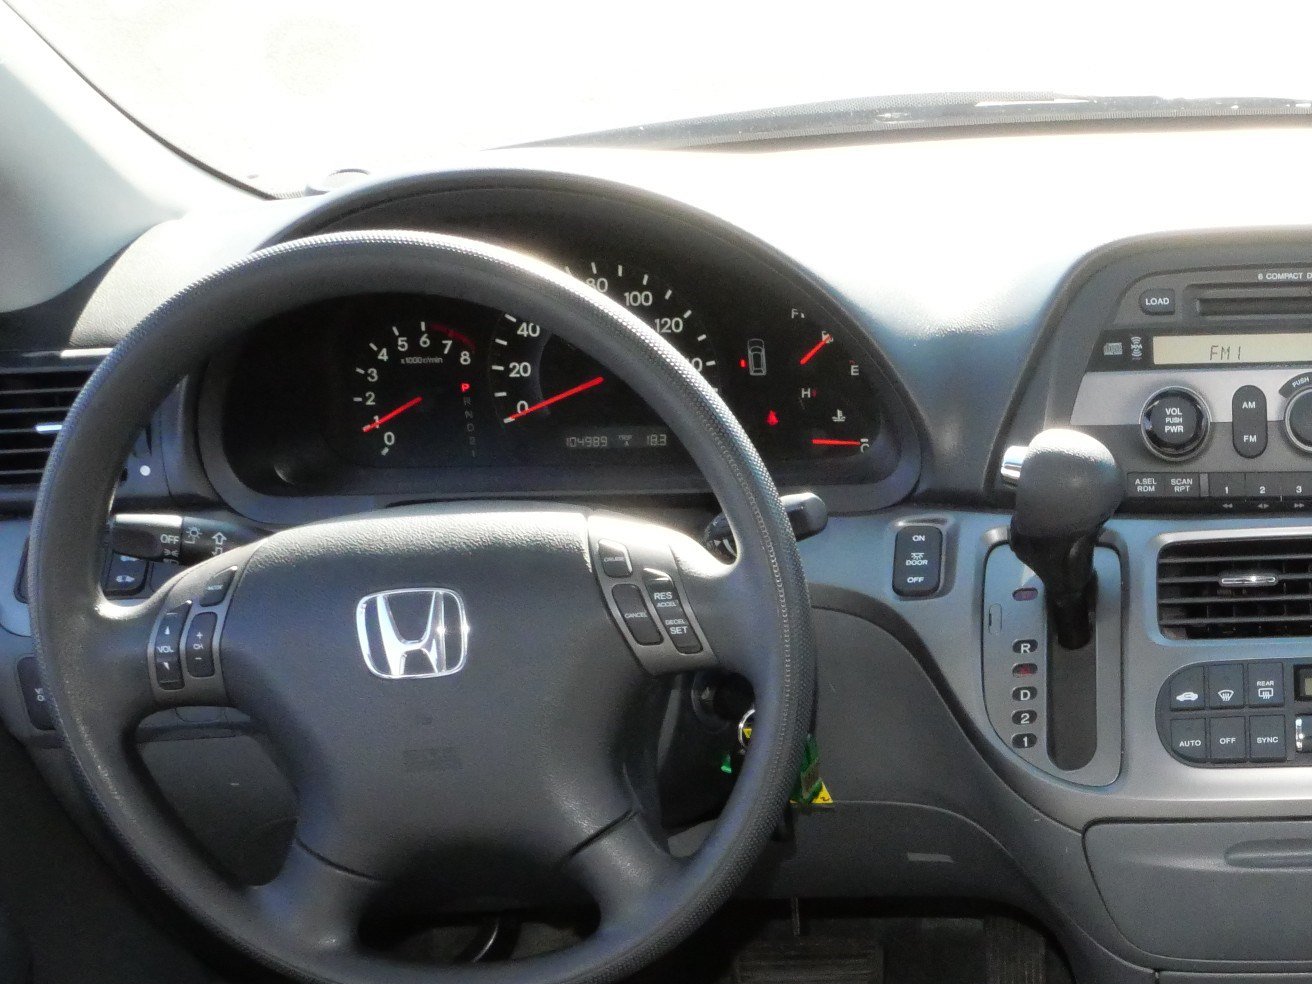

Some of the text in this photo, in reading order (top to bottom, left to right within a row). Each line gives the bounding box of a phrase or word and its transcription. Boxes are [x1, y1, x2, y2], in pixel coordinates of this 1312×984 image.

[1257, 272, 1264, 280] 6
[1266, 272, 1303, 280] COMPACT
[624, 291, 653, 307] 100
[1145, 298, 1170, 306] LOAD
[791, 308, 799, 319] F
[516, 322, 540, 338] 40
[654, 318, 684, 333] 120
[397, 336, 408, 352] 5
[420, 333, 430, 348] 6
[442, 340, 452, 354] 7
[1210, 344, 1242, 360] FM1
[377, 348, 388, 362] 4
[460, 350, 471, 365] 8
[366, 368, 378, 382] 3
[508, 362, 532, 378] 20
[850, 364, 860, 376] E
[461, 382, 470, 392] P
[1292, 376, 1310, 388] PUSH
[365, 391, 376, 406] 2
[801, 388, 811, 398] H
[516, 400, 529, 414] 0
[1242, 401, 1256, 409] AM
[1165, 408, 1182, 416] VOL
[384, 432, 396, 446] 0
[566, 436, 608, 448] 104989
[1224, 486, 1229, 494] 1
[1260, 486, 1266, 494] 2
[1296, 485, 1302, 494] 3
[160, 534, 180, 544] OFF
[912, 534, 926, 542] ON
[906, 576, 924, 584] OFF
[654, 592, 673, 600] RES
[665, 618, 686, 626] DECEL
[670, 626, 688, 635] SET
[156, 644, 175, 653] VOL
[1020, 644, 1030, 654] R
[1020, 690, 1030, 701] D
[1020, 712, 1030, 724] 2
[1022, 736, 1028, 747] 1
[1256, 736, 1278, 744] SYNC
